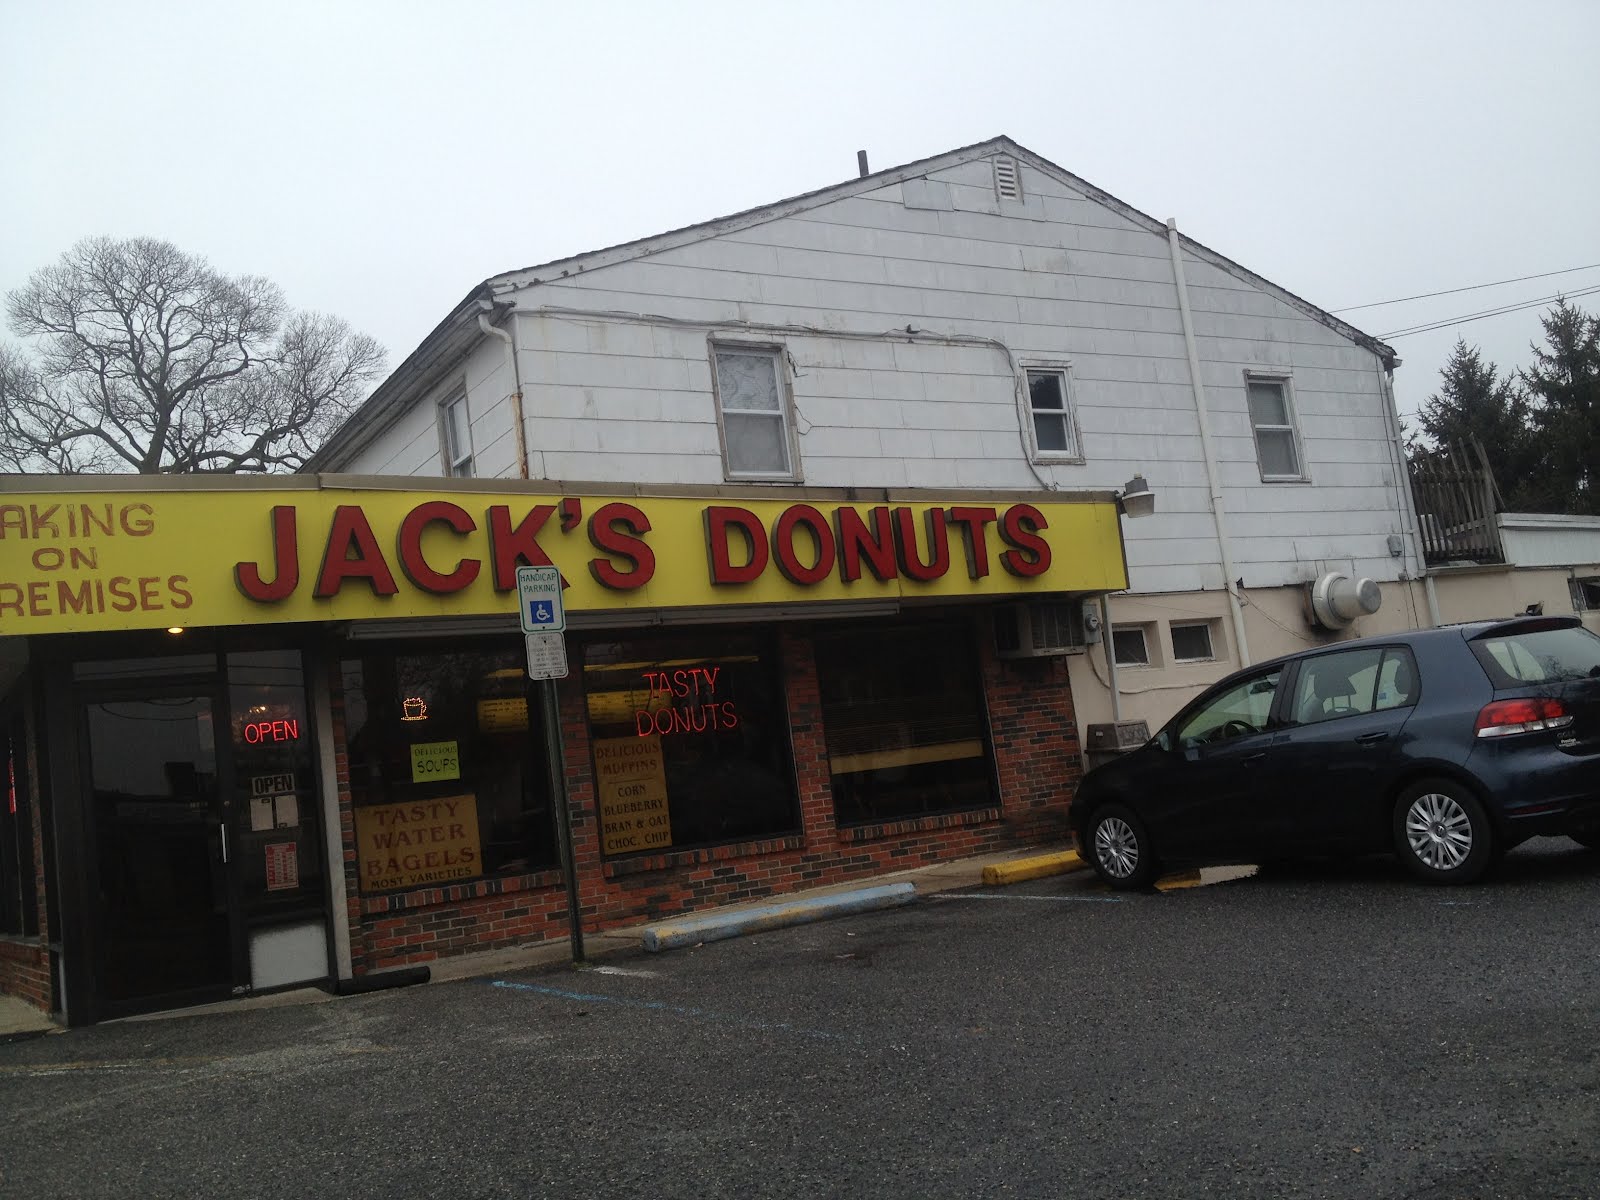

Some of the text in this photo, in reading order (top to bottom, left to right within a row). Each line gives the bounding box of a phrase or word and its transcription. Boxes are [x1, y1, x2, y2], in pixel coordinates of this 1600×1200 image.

[31, 547, 98, 571] ON
[234, 497, 1052, 603] JACK'S DONUTS
[520, 573, 557, 583] HANDICAP
[523, 584, 556, 593] PARKING
[642, 667, 720, 699] TASTY
[635, 702, 738, 737] DONUTS
[244, 720, 298, 744] OPEN
[595, 743, 660, 760] DELICIOUS
[416, 758, 457, 774] SOUPS
[602, 759, 658, 776] MUFFINS
[255, 774, 293, 795] OPEN
[617, 784, 647, 798] CORN
[373, 800, 459, 827] TASTY
[604, 799, 664, 817] BLUEBERRY
[604, 815, 668, 834] BRAN & OAT
[373, 823, 466, 850] WATER
[607, 831, 669, 850] CHOC. CHIP
[367, 847, 475, 877] BAGELS
[370, 866, 473, 889] MOST VARIETIES
